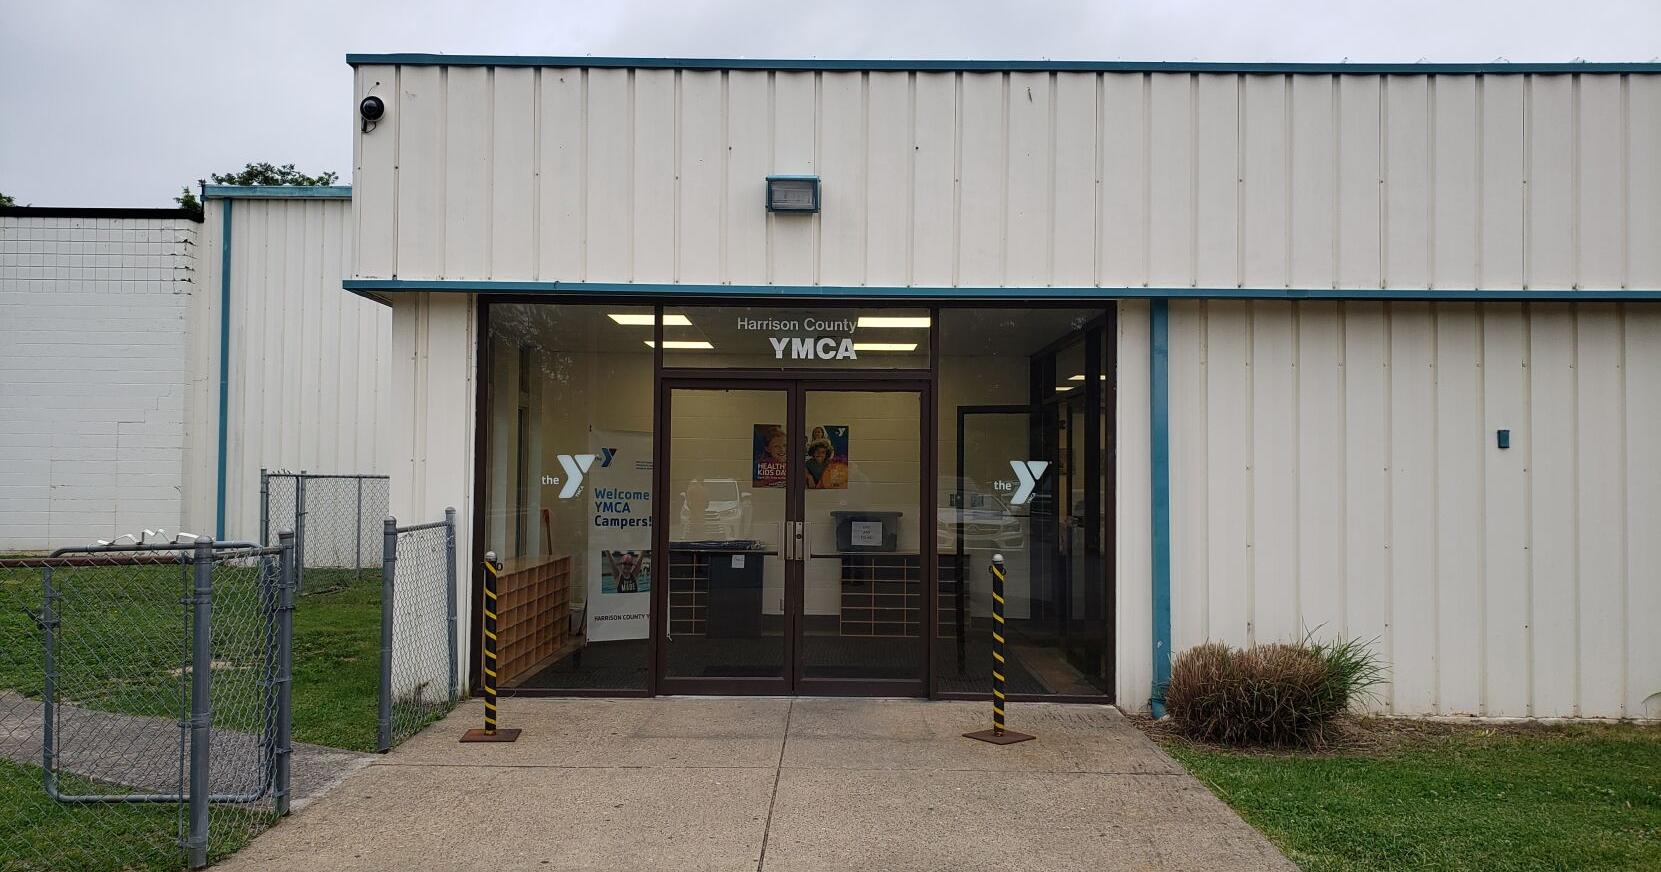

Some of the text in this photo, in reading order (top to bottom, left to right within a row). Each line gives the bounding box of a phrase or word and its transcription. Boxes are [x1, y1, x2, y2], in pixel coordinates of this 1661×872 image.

[737, 317, 858, 334] Harrison County
[768, 337, 857, 360] YMCA
[541, 475, 560, 485] the
[993, 480, 1012, 490] the
[594, 488, 650, 500] Welcome
[594, 501, 631, 514] YMCA
[594, 515, 653, 530] Campers!
[622, 613, 645, 621] COUNTY
